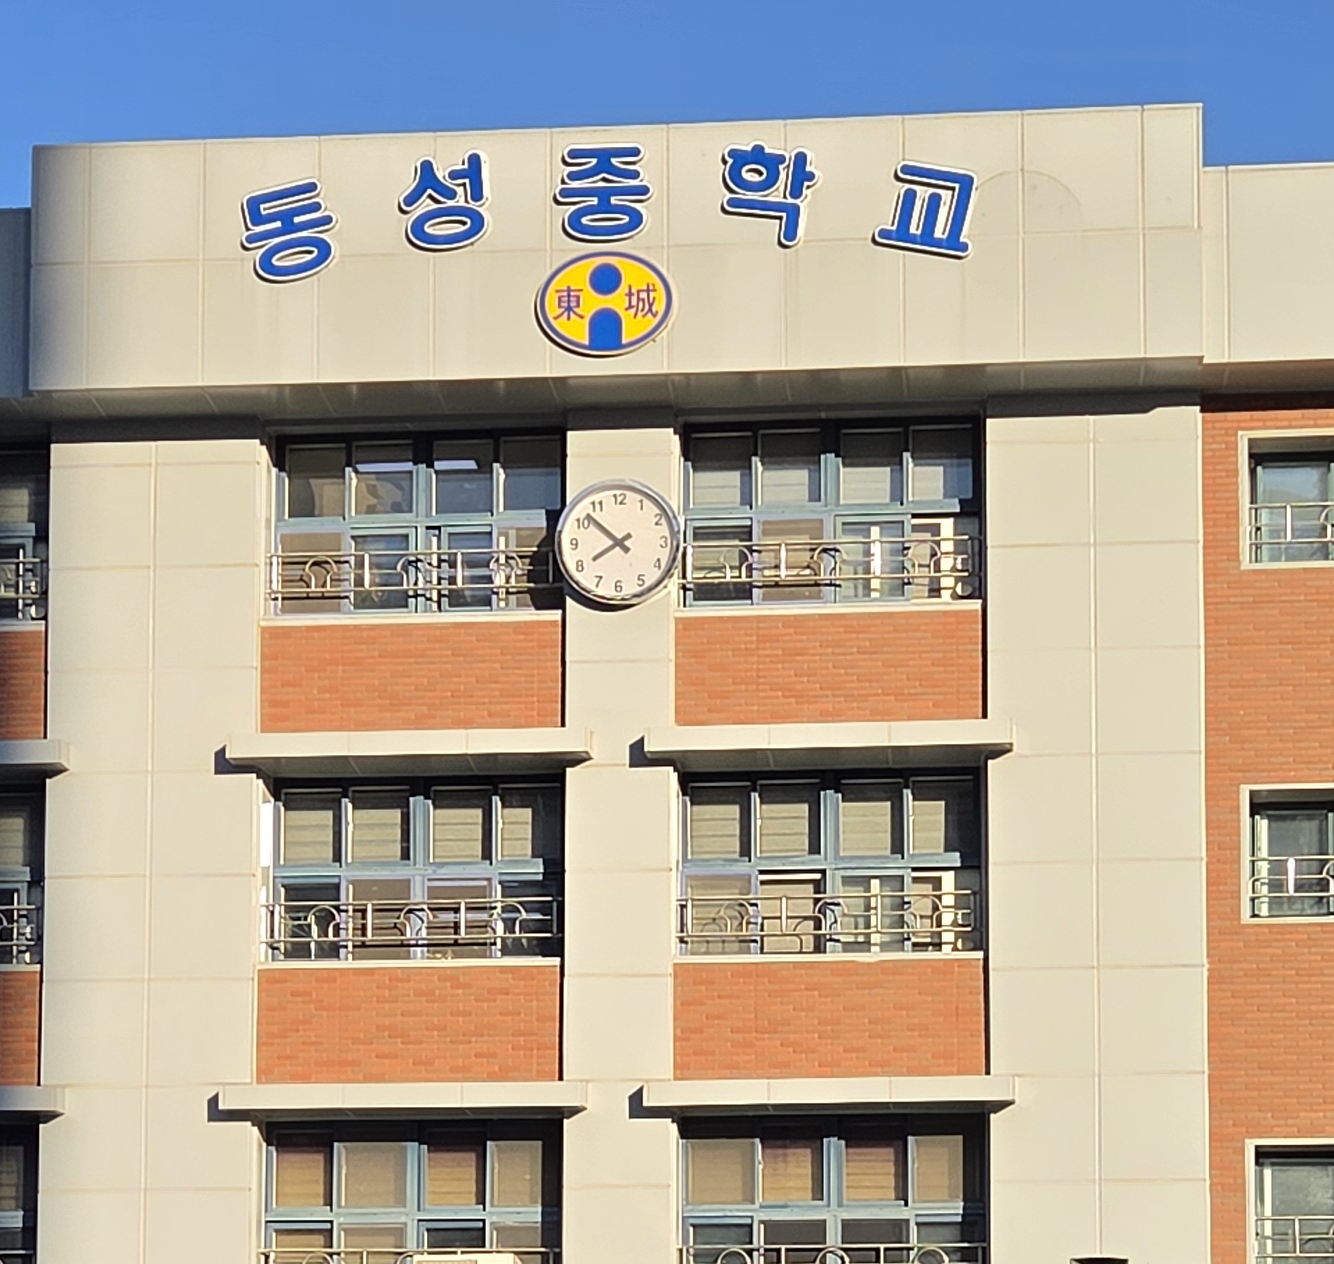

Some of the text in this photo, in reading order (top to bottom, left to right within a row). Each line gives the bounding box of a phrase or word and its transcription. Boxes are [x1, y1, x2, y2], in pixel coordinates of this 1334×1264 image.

[242, 141, 978, 282] 동성중학교
[612, 493, 627, 506] 12
[638, 499, 644, 511] 1
[590, 500, 603, 513] 11
[575, 515, 591, 530] 10
[654, 513, 663, 526] 2
[570, 537, 578, 550] 9
[659, 535, 668, 548] 3
[575, 559, 584, 573] 8
[653, 557, 661, 570] 4
[594, 575, 603, 588] 7
[614, 580, 623, 593] 6
[636, 574, 645, 587] 5
